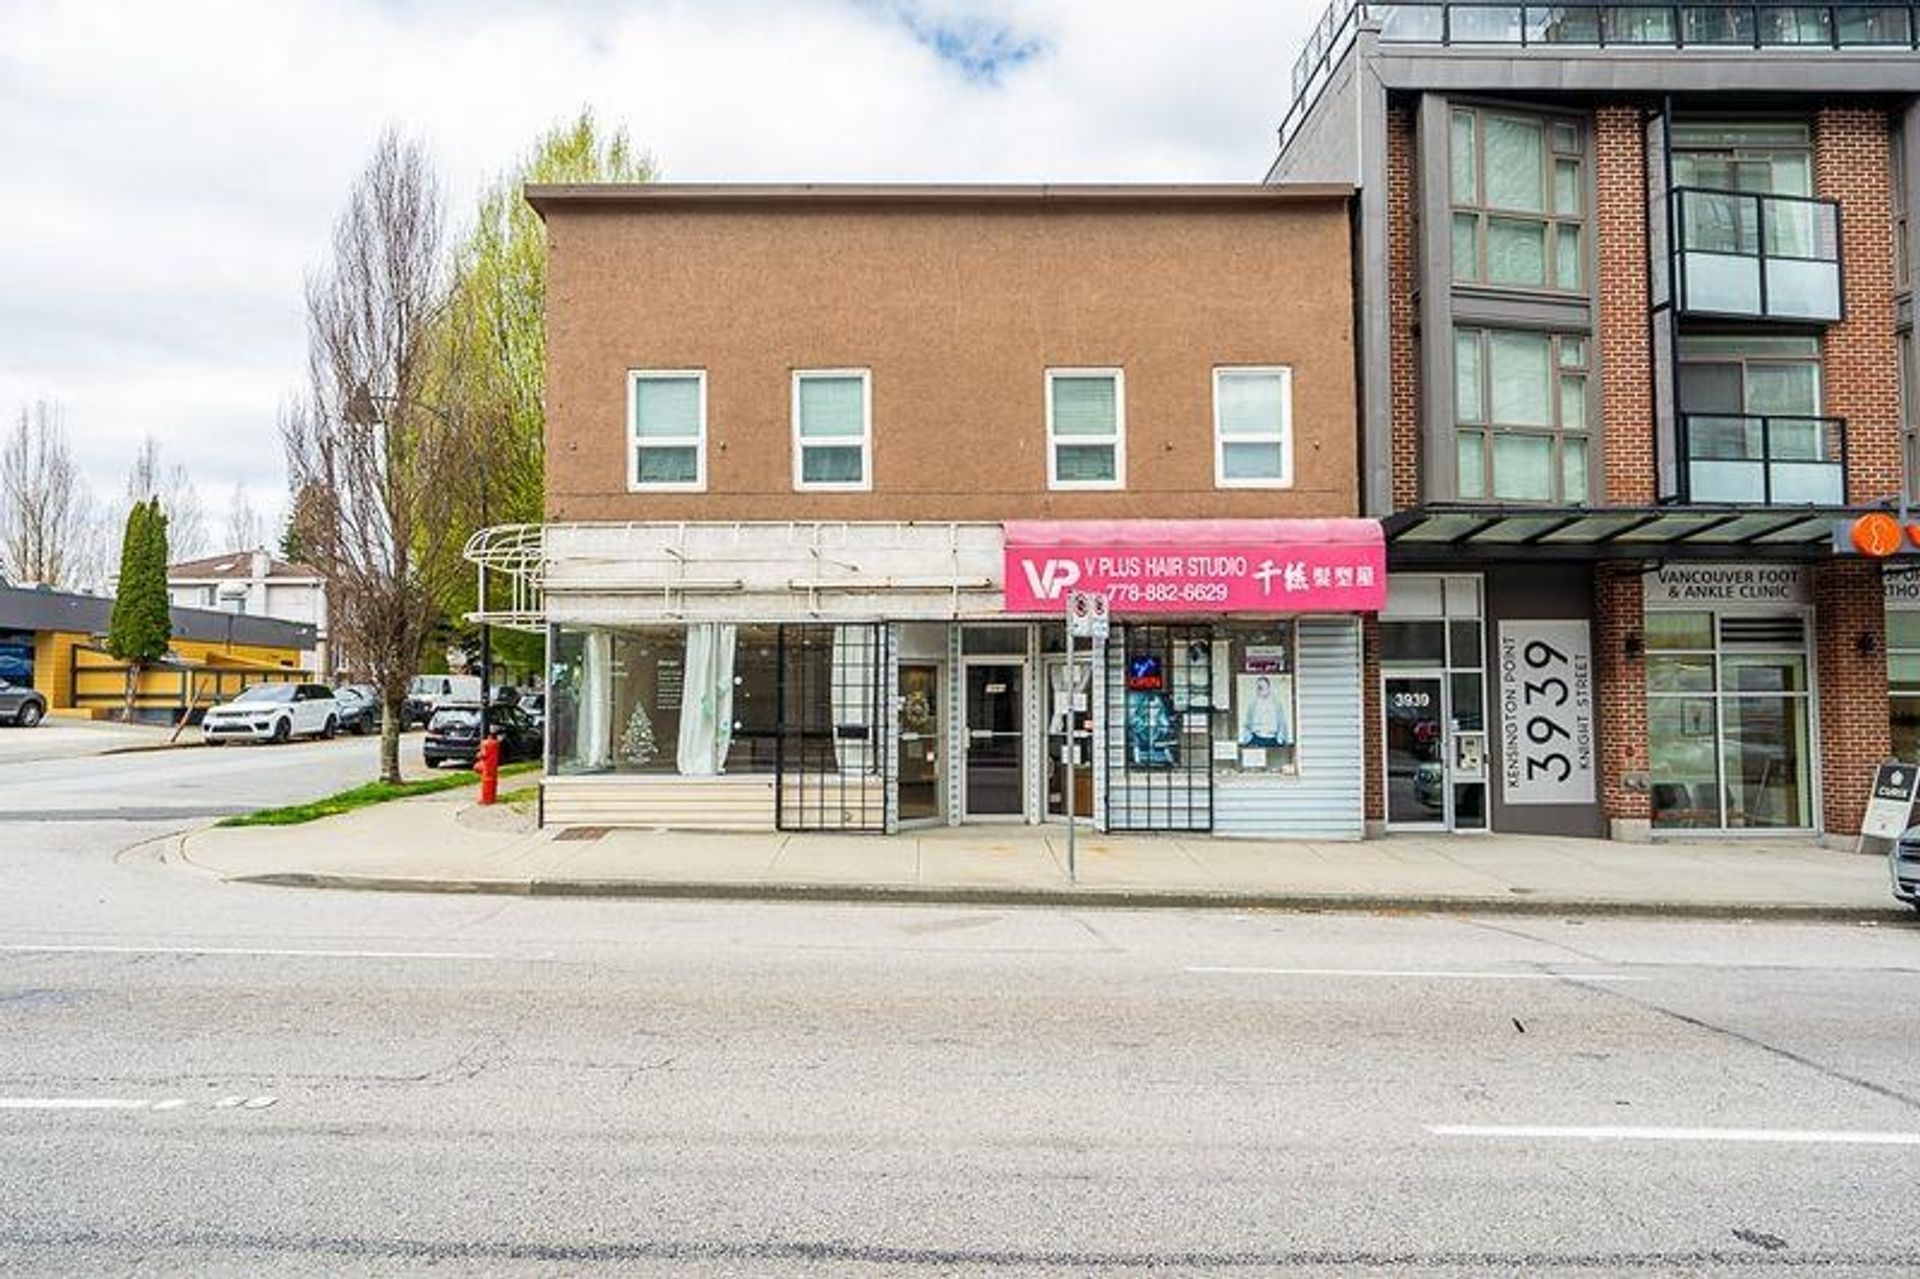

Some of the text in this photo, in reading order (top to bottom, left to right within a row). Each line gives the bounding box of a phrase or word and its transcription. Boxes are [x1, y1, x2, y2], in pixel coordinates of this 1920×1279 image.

[1083, 556, 1248, 577] V PLUS HAIR STUDIO
[1659, 569, 1798, 584] VANCOUVER FOOT
[1021, 558, 1081, 600] VP
[1106, 583, 1228, 602] 778-882-6629
[1668, 585, 1790, 599] & ANKLE CLINIC
[1394, 692, 1430, 707] 3939
[1503, 636, 1520, 788] KENSINGTON POINT
[1524, 640, 1572, 783] 3939
[1575, 654, 1591, 770] KNIGHT STREET
